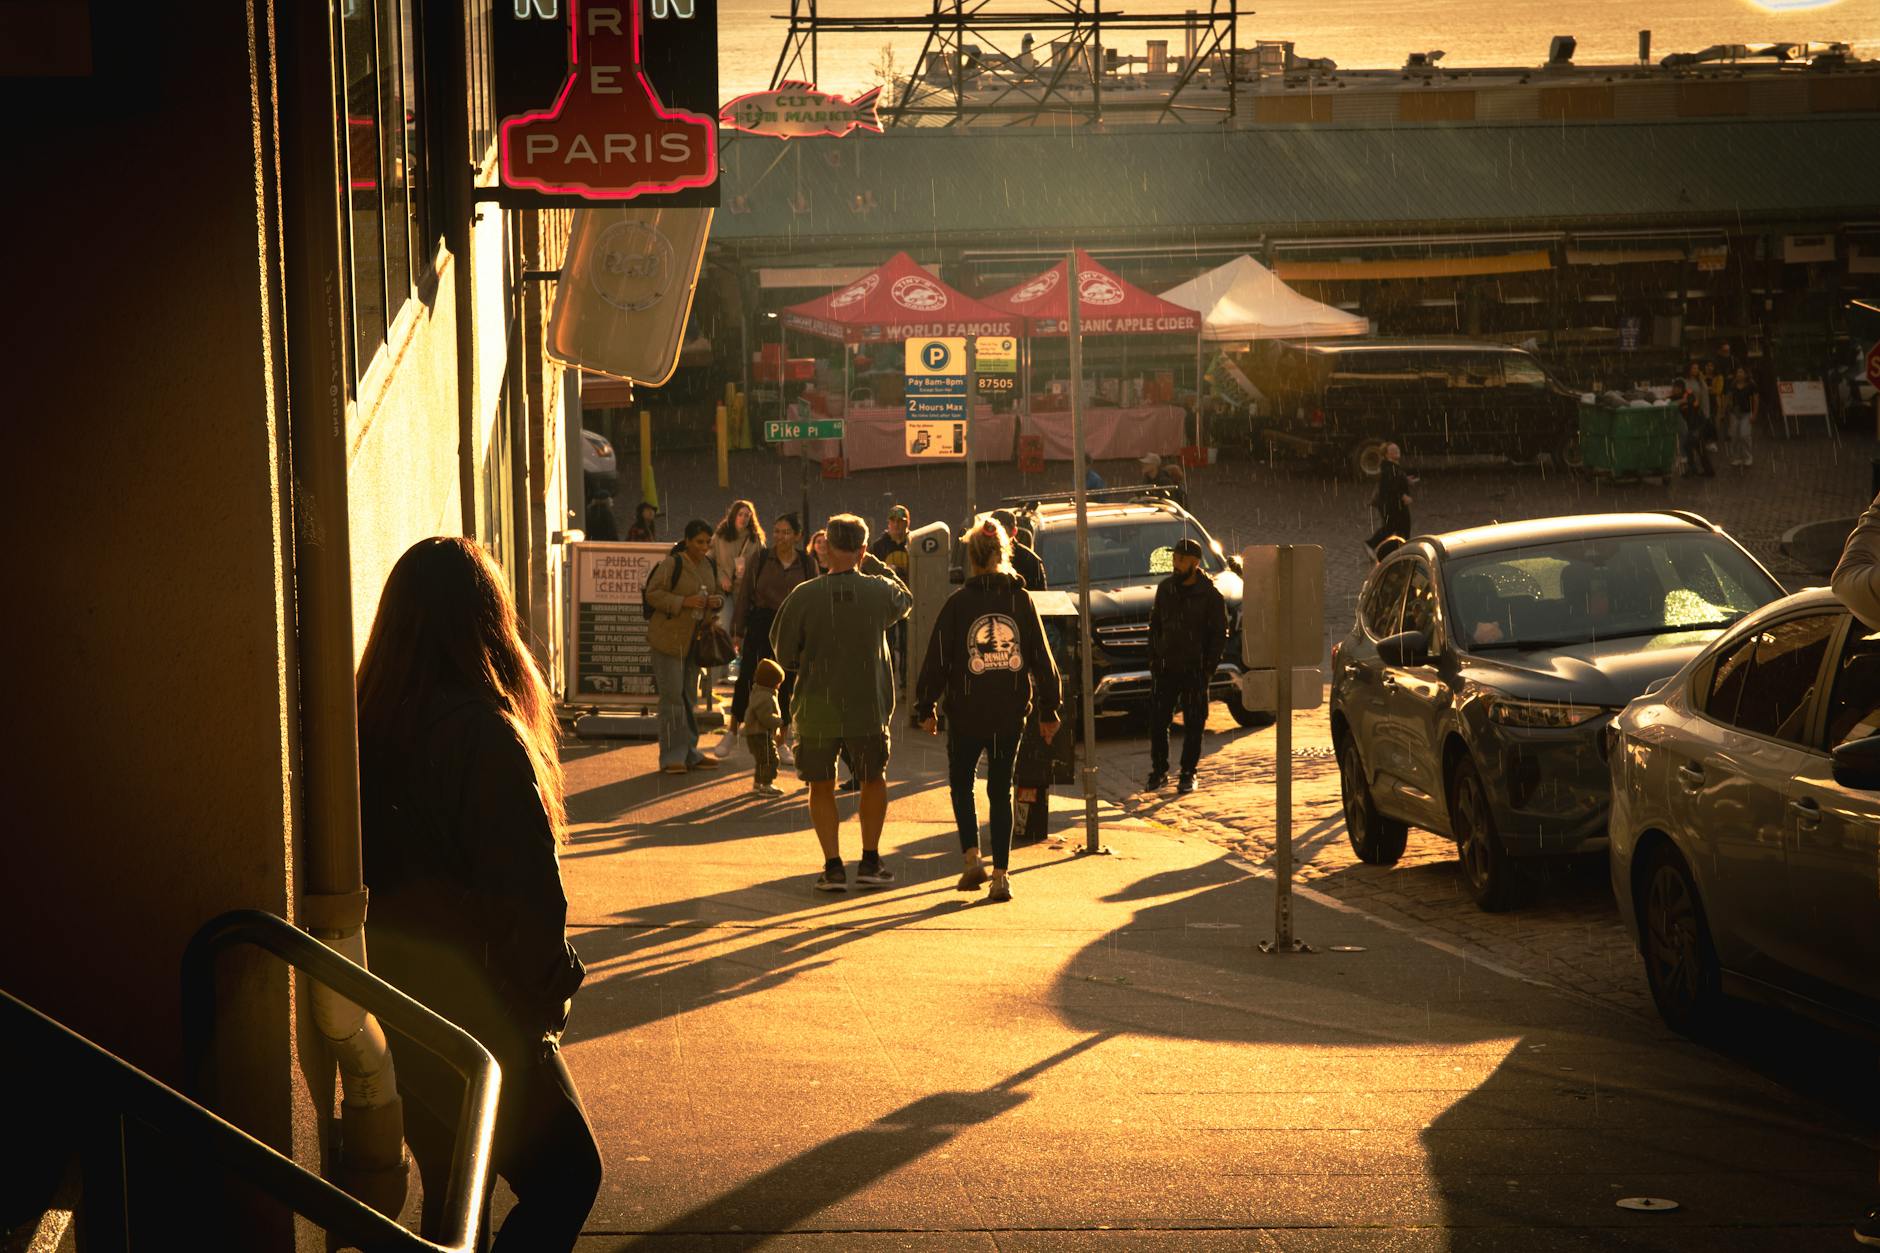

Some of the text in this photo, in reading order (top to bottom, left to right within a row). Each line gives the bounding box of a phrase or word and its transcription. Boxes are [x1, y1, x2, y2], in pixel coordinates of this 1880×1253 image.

[785, 111, 862, 123] MARKET
[526, 133, 691, 164] PARIS
[1058, 316, 1194, 332] OGANIC APPLE CIDER
[886, 322, 1011, 340] WORLD FAMOUS
[930, 348, 944, 365] P
[908, 377, 963, 387] Pay 8am-8pm
[979, 379, 1013, 388] 87505
[909, 400, 963, 411] 2 Hours Max
[770, 423, 800, 437] Pike
[808, 426, 818, 437] Pl
[606, 556, 646, 567] PUBLIC
[592, 568, 637, 580] MARKET
